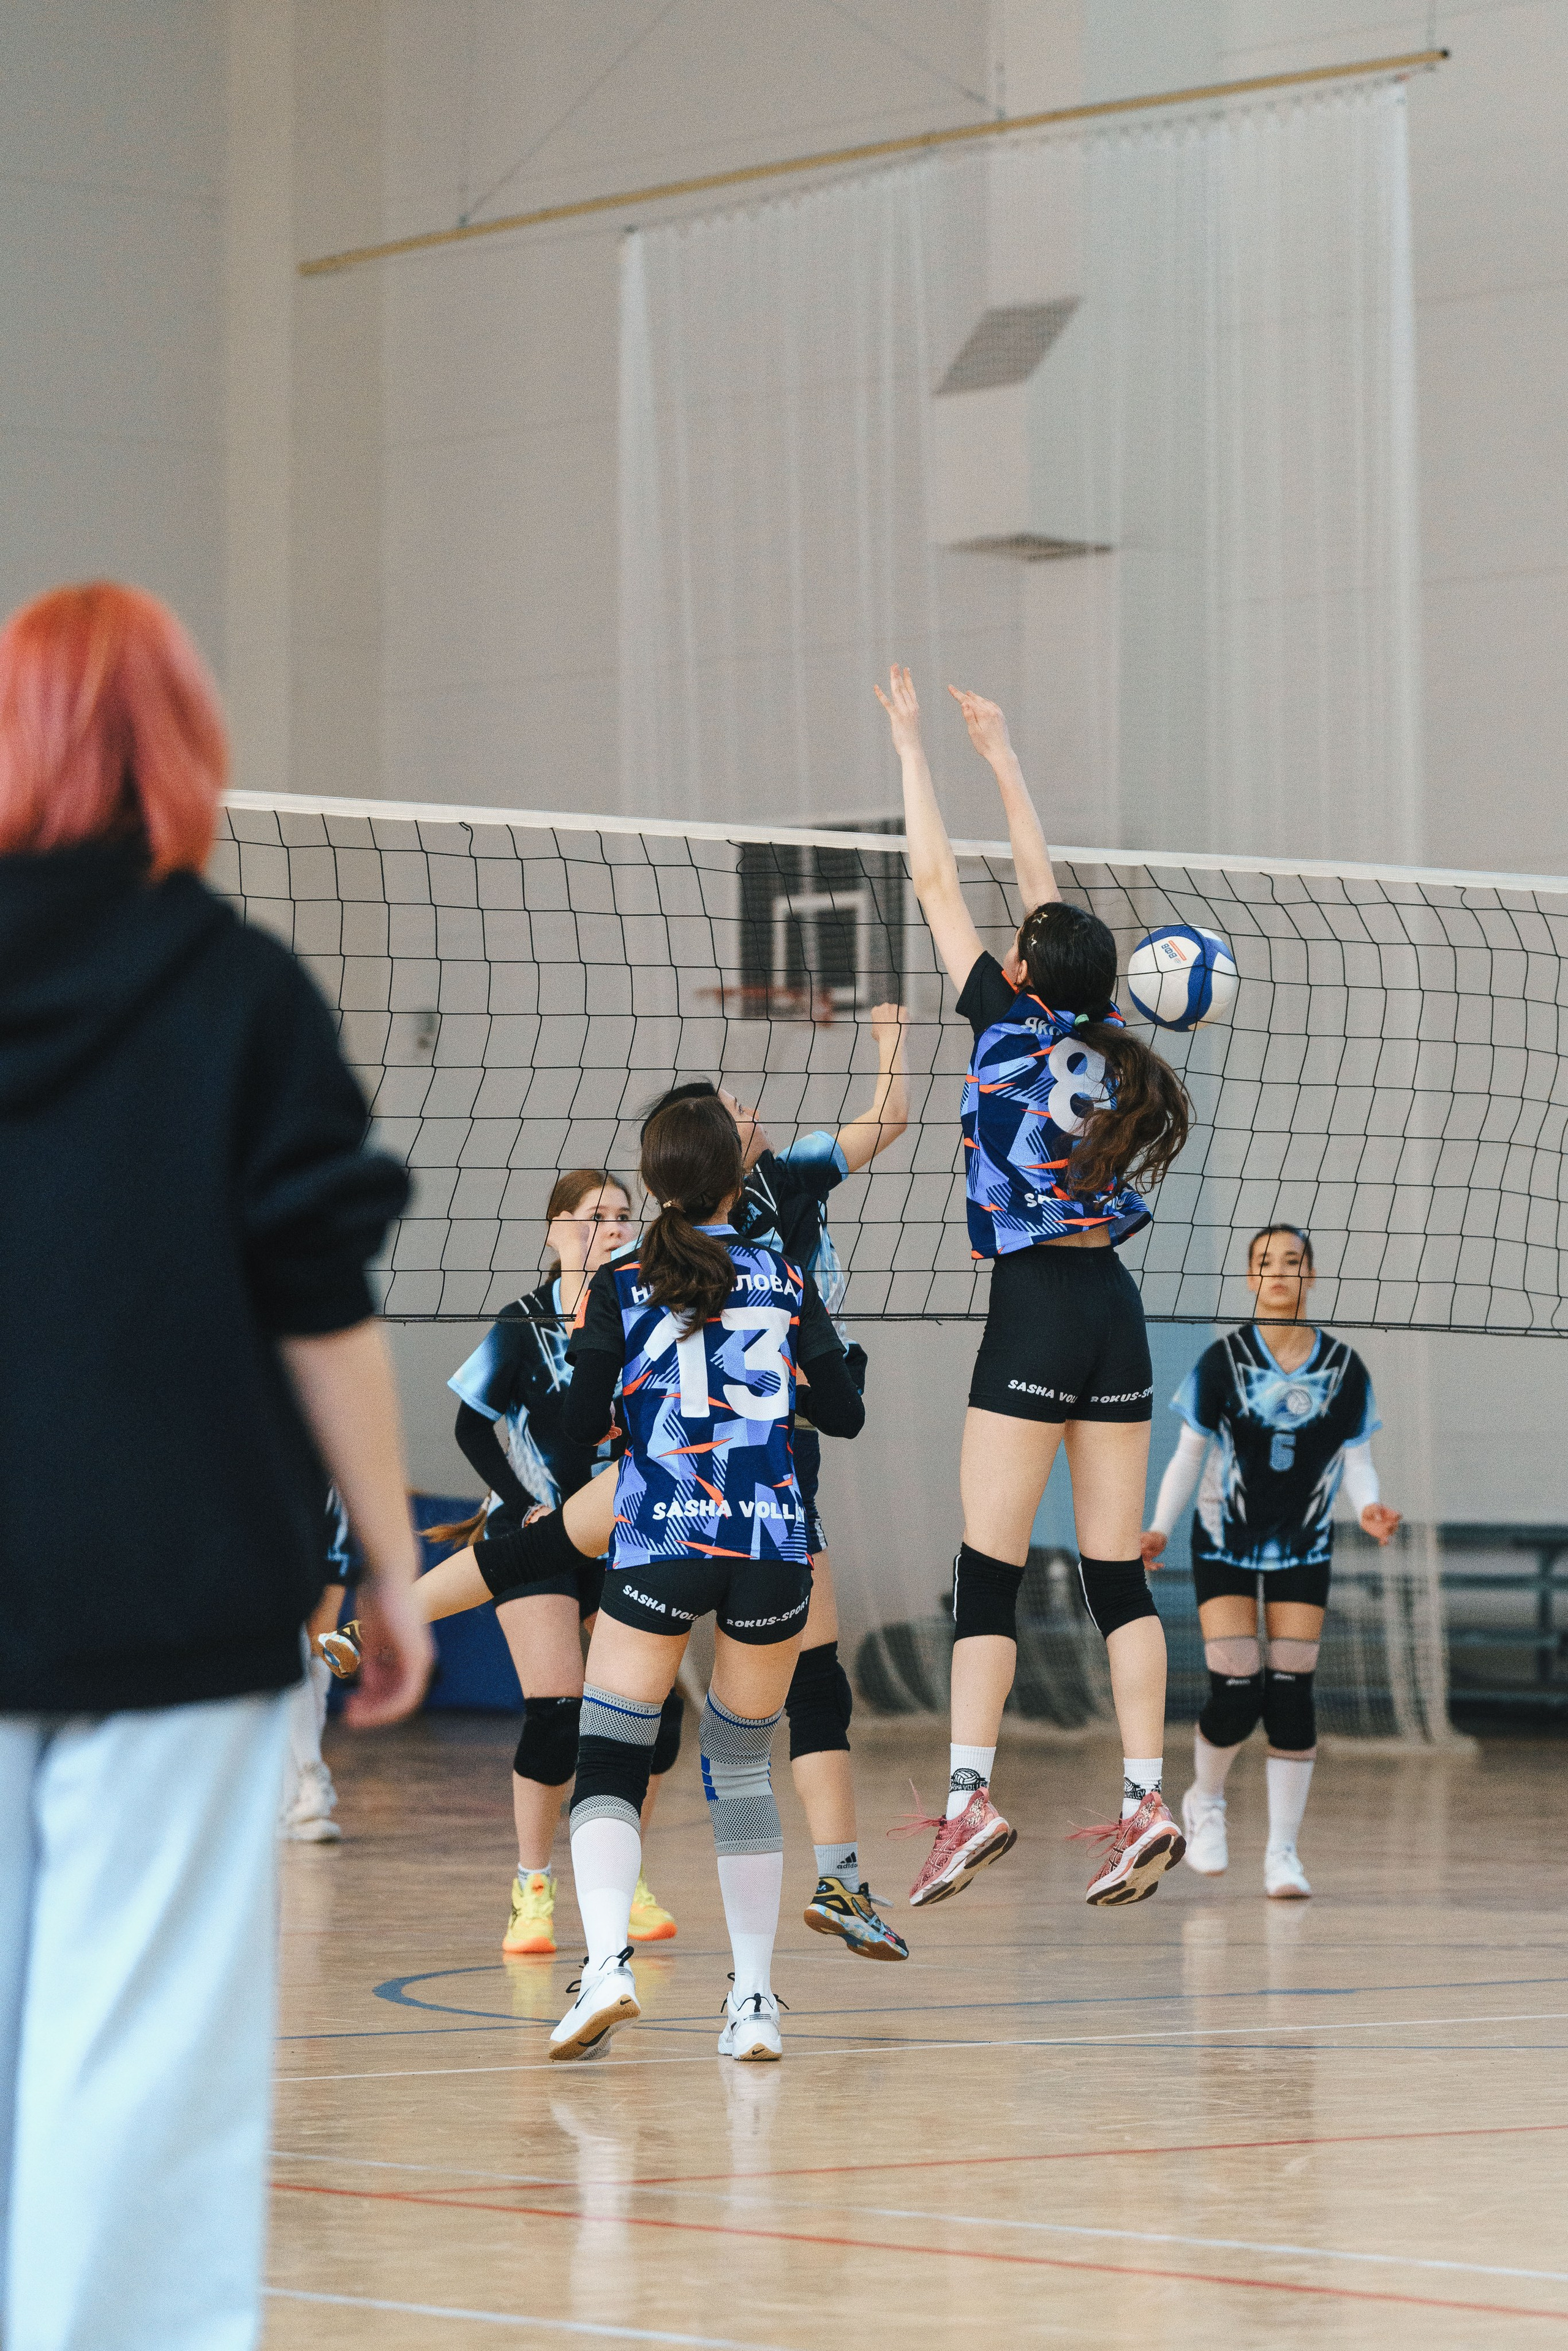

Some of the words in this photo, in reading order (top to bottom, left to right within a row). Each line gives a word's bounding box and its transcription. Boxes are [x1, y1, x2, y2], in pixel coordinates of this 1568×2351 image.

[1048, 1036, 1112, 1138] 8
[644, 1306, 791, 1421] 13
[1008, 1379, 1055, 1398] SASHA
[652, 1499, 733, 1520] SASHA
[622, 1585, 666, 1613] SASHA
